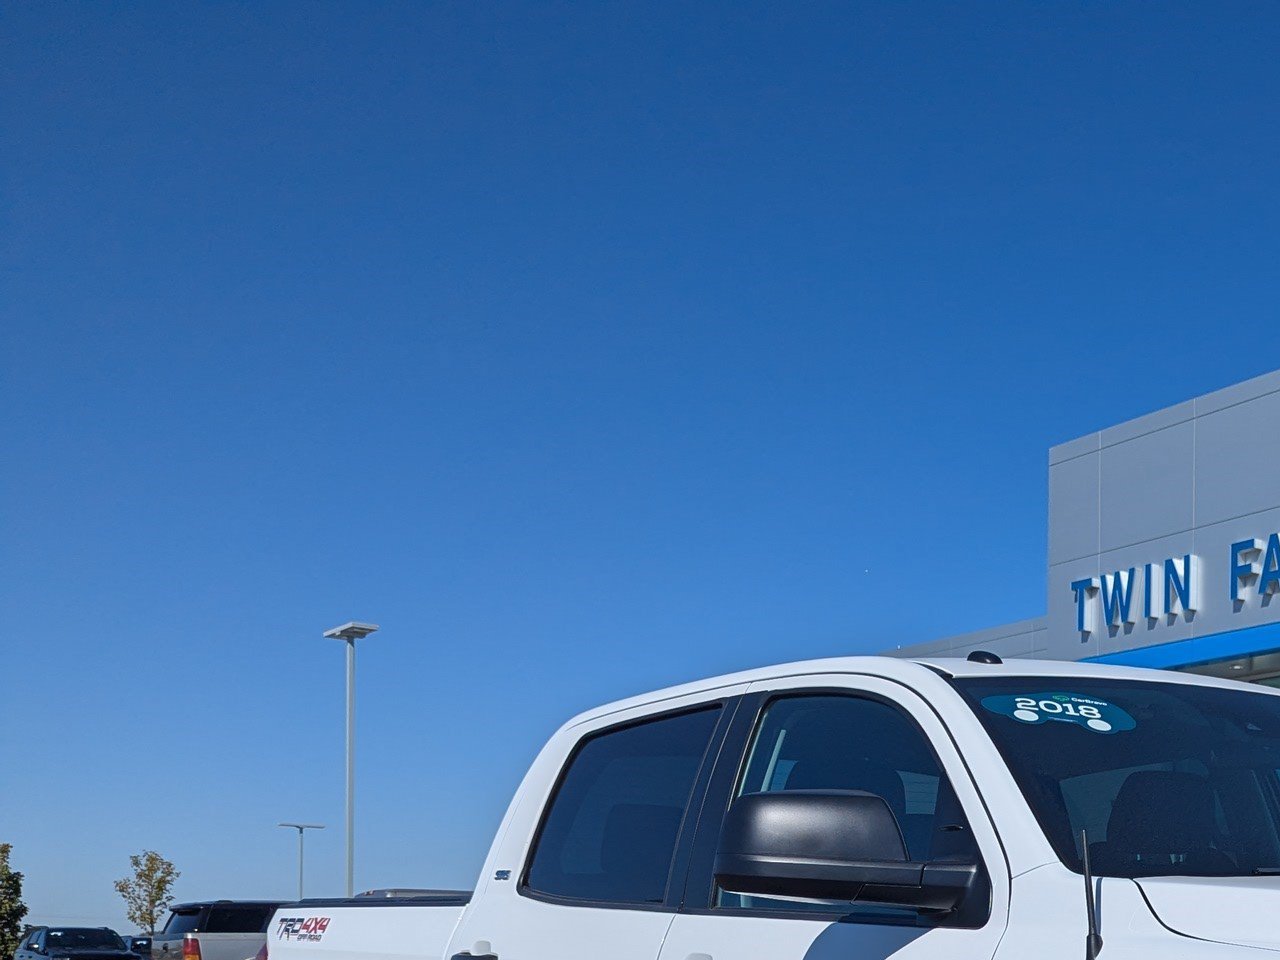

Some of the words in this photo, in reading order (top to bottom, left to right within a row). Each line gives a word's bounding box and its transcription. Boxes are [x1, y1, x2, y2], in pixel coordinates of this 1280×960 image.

[1071, 554, 1198, 633] TWIN
[1014, 697, 1102, 719] 2018
[277, 917, 305, 941] TRD
